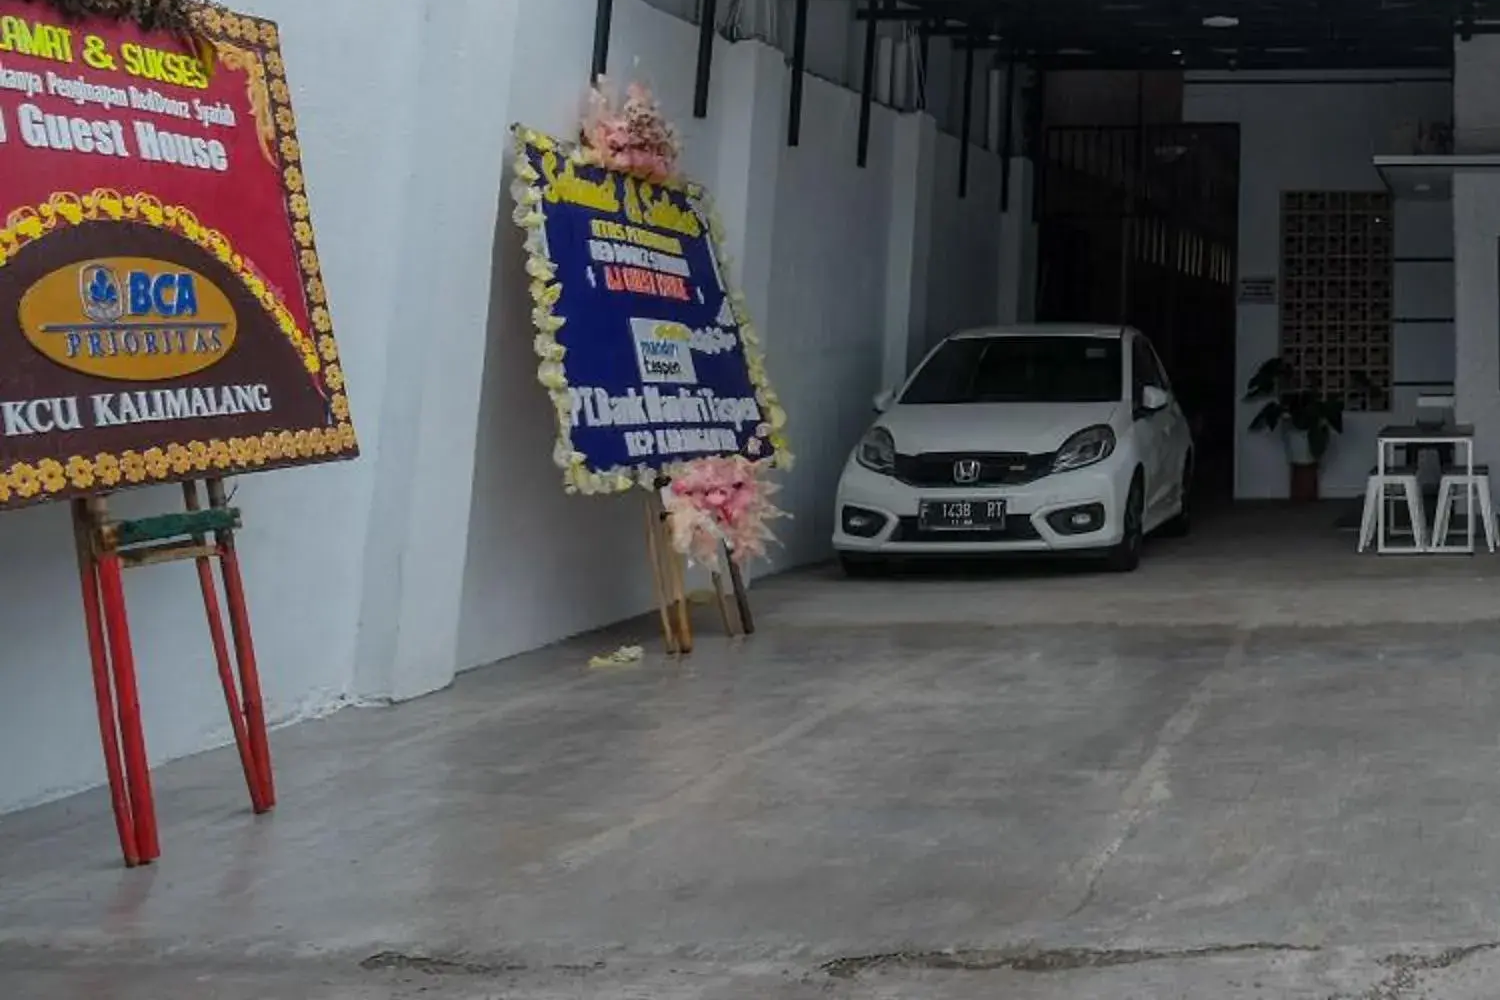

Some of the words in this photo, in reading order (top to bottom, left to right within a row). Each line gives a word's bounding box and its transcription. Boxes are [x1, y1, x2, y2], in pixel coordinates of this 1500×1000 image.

[0, 16, 73, 62] AMAT
[84, 36, 117, 71] &
[120, 43, 209, 88] SUKSES
[17, 103, 130, 157] Guest
[133, 119, 229, 171] House
[128, 271, 198, 316] BCA
[66, 329, 223, 357] PRIORITAS
[1, 396, 83, 436] KCU
[90, 384, 272, 427] KALIMALANG
